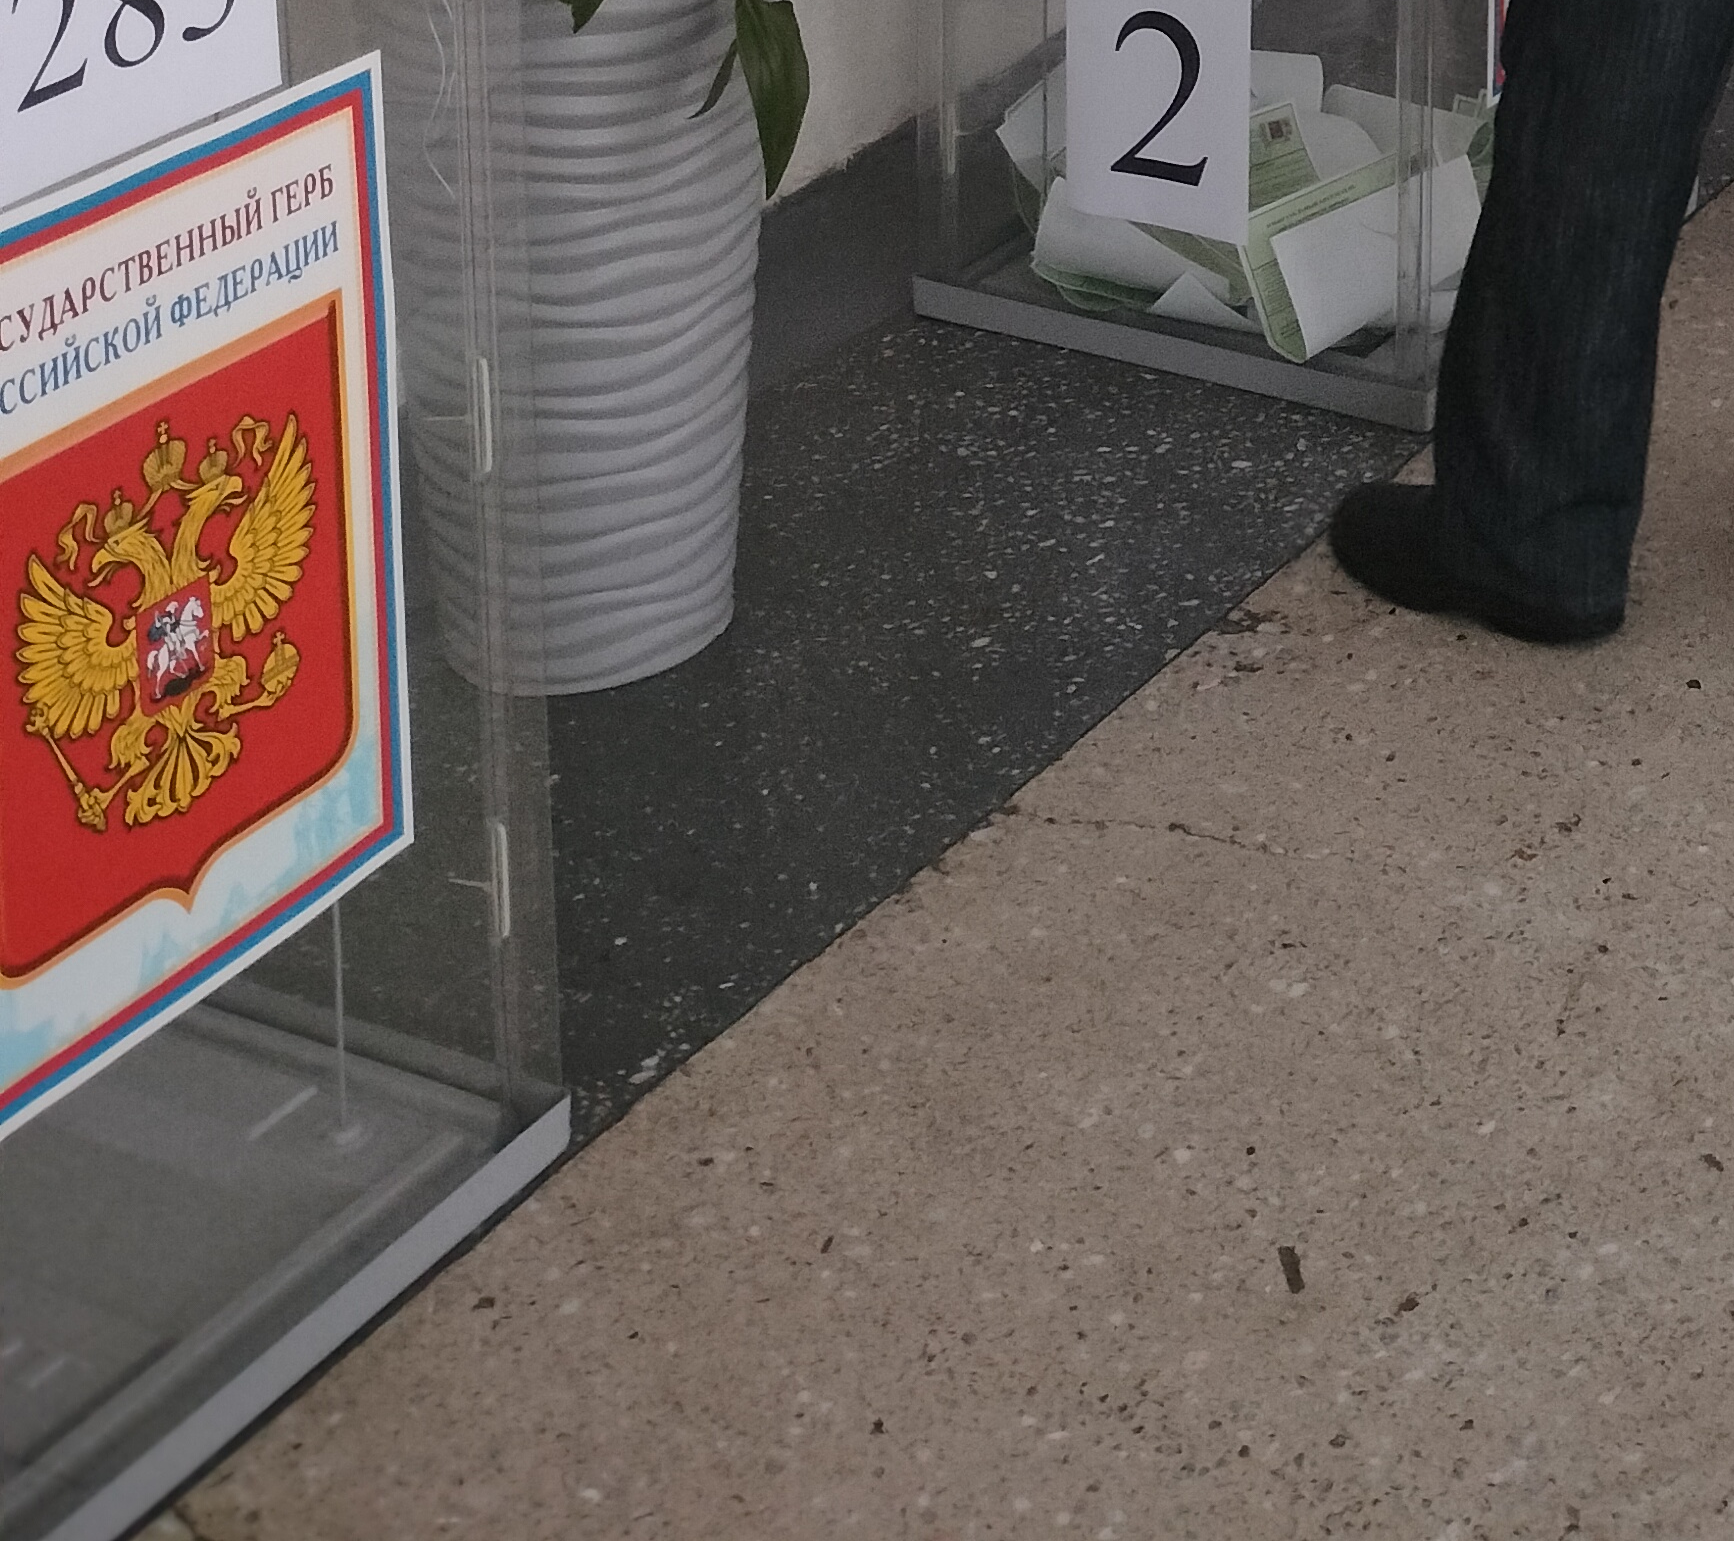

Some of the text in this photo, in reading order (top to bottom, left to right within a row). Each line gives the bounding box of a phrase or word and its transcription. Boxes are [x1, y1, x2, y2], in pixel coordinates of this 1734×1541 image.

[1107, 9, 1210, 187] 2
[0, 163, 335, 352] СУДАРСТВЕННЫЙ ГЕРБ
[0, 220, 340, 415] ССИЙСКОЙ ФЕДЕРАЦИИ
